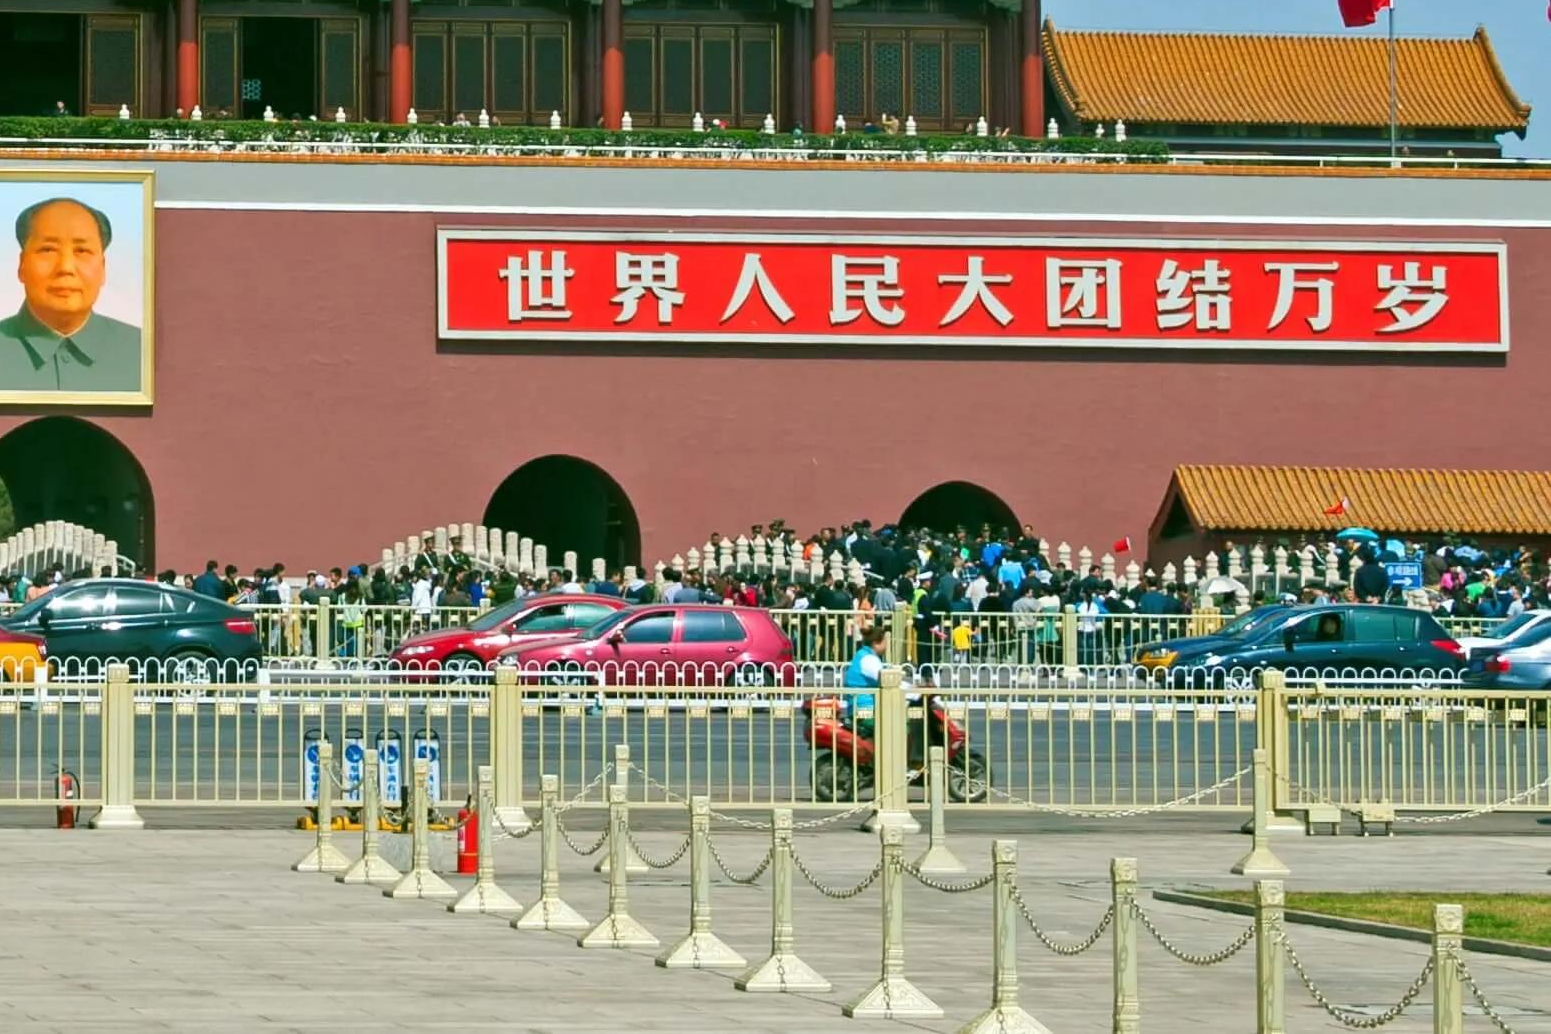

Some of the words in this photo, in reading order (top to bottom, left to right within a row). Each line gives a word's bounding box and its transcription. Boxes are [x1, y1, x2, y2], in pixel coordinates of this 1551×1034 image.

[498, 250, 1450, 332] 世界人民大团结万岁
